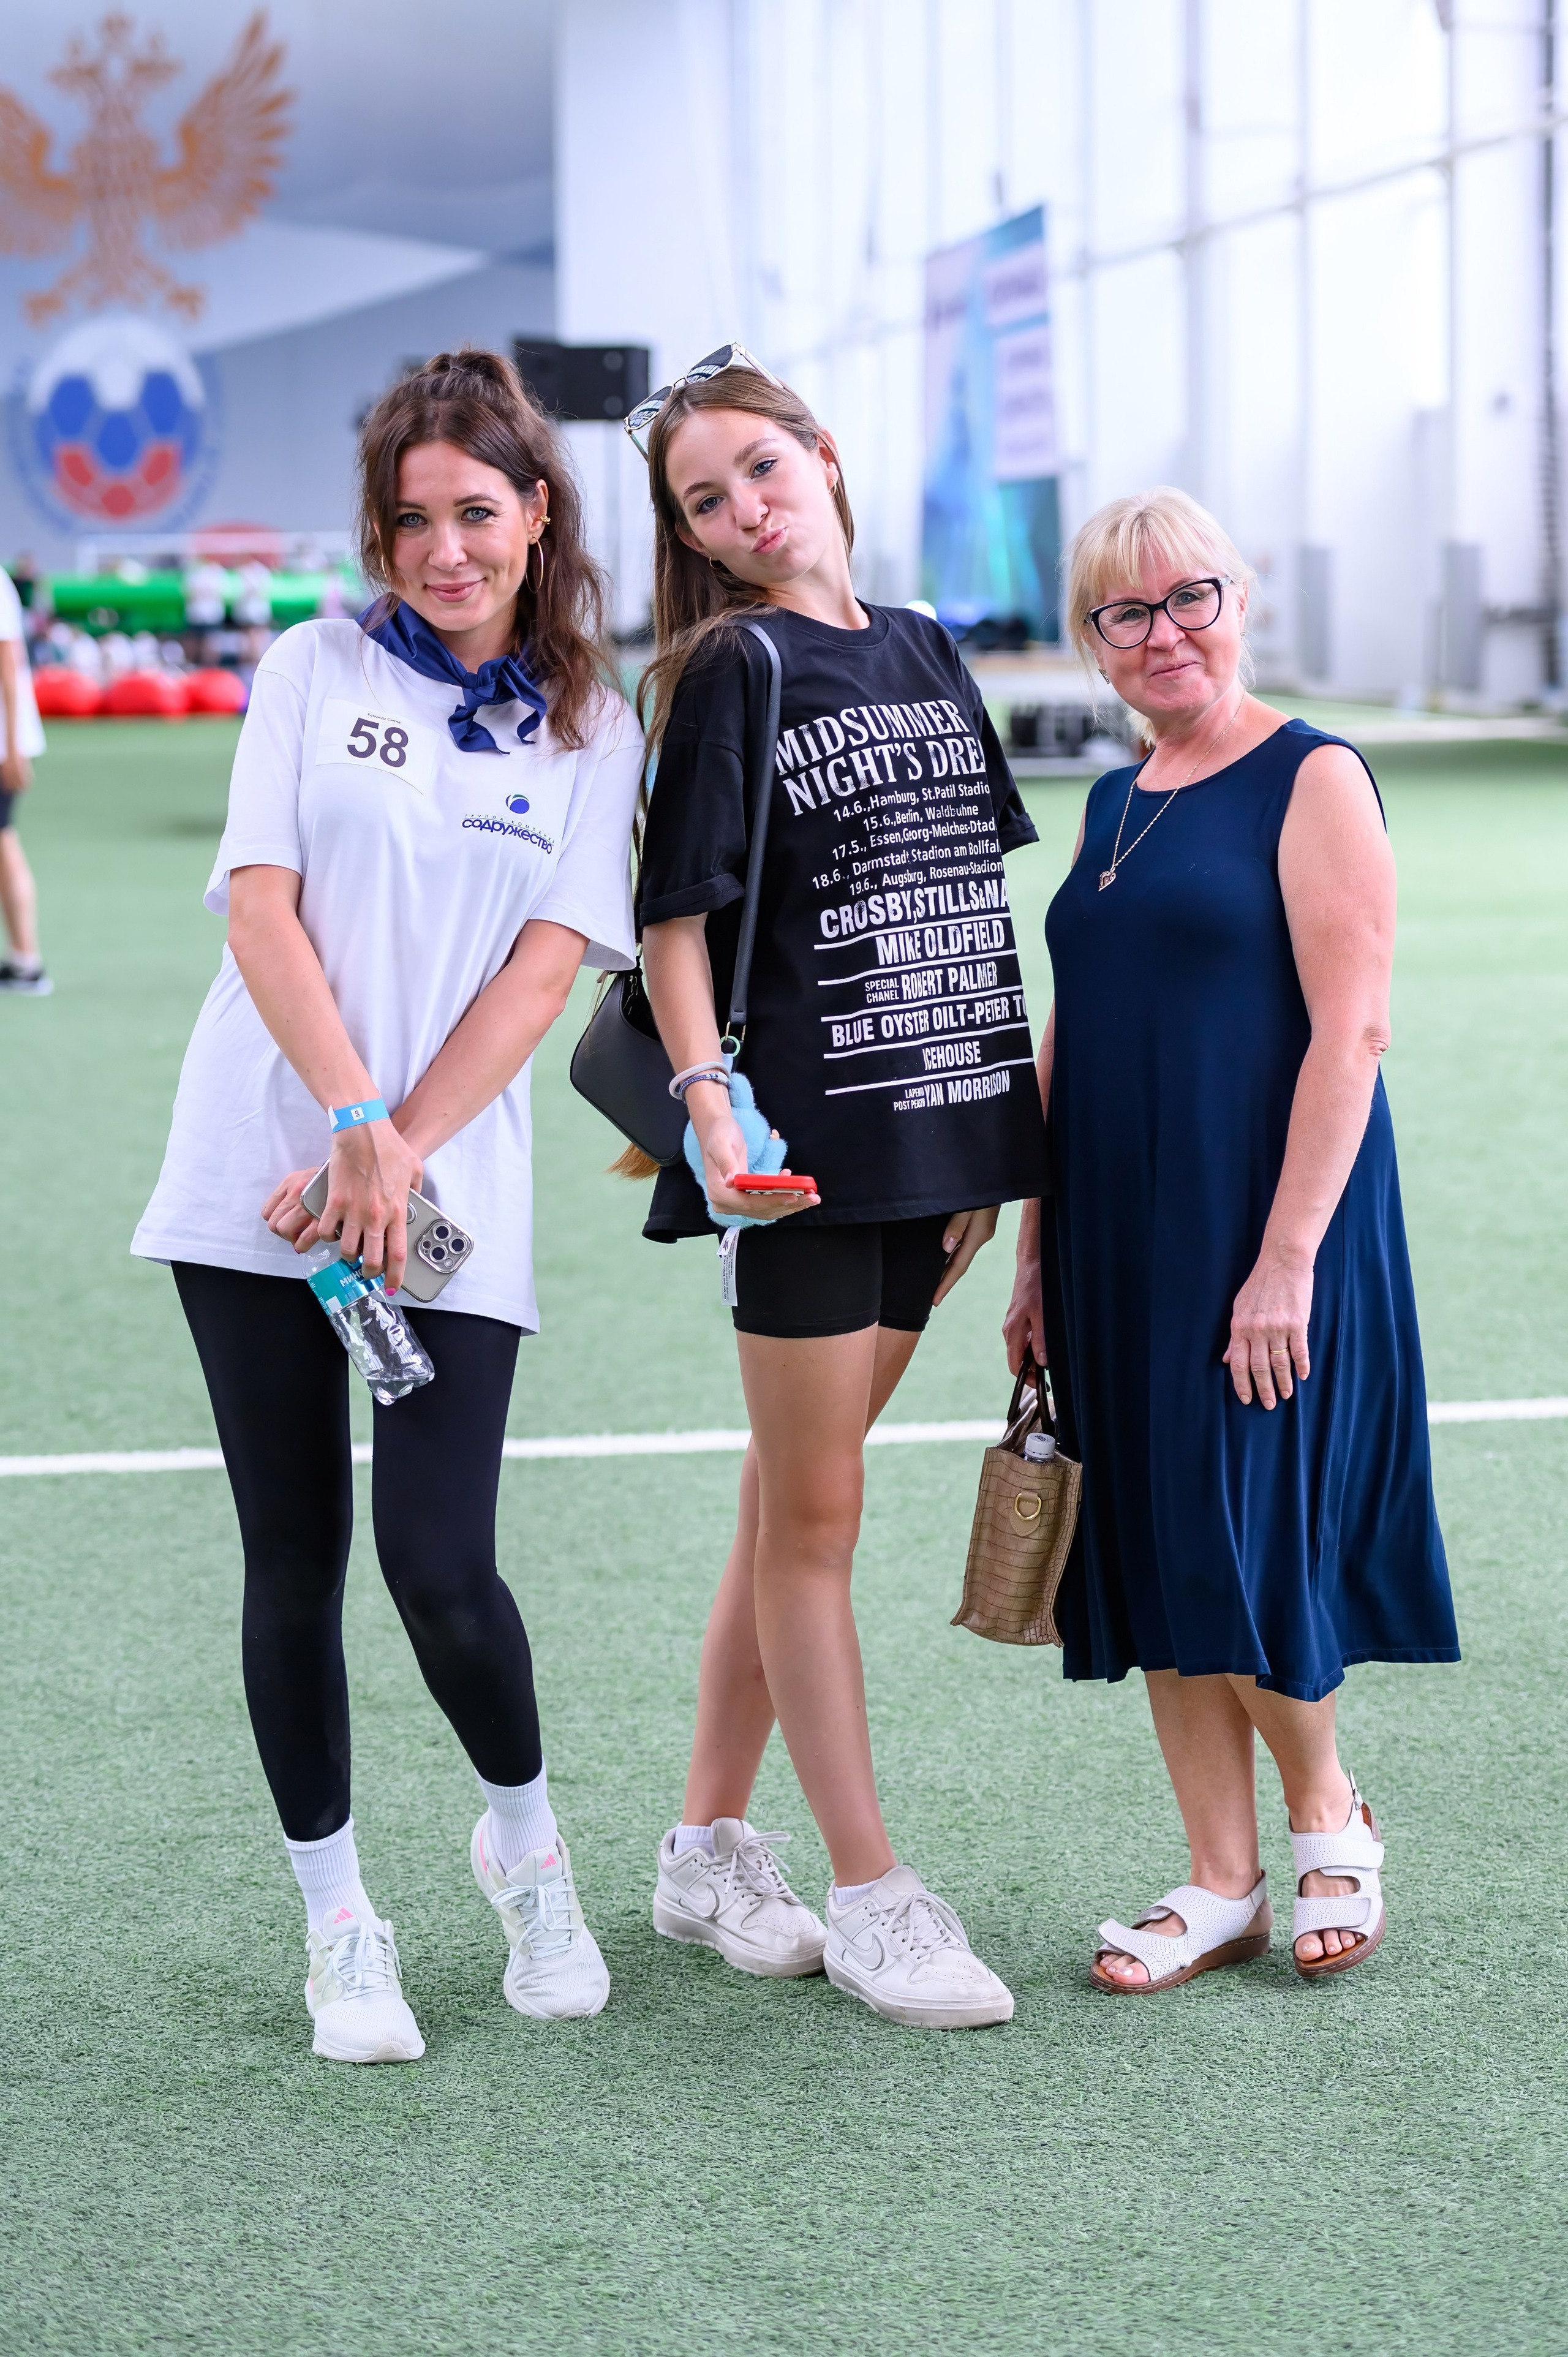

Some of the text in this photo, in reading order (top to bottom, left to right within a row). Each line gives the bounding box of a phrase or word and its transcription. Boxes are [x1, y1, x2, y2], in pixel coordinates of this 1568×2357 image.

[347, 717, 409, 767] 58
[775, 700, 970, 775] MIDSUMMER
[782, 736, 986, 816] NIGHT'S DRE
[832, 840, 867, 860] 17.5.,
[911, 845, 951, 862] Stadion
[954, 845, 967, 857] am
[850, 878, 877, 896] 19.6.,
[930, 859, 1003, 880] Rosenau-Stadion
[875, 919, 1005, 965] MIKE OLDFIELD
[865, 978, 899, 992] SPECIAL
[866, 961, 998, 1003] CHANEL ROBERT PALMER
[832, 1018, 875, 1047] BLUE
[881, 1009, 929, 1038] OYSTER
[922, 1041, 981, 1071] ICEHOUSE
[894, 1100, 910, 1111] POST
[946, 1070, 1010, 1104] MORRISON
